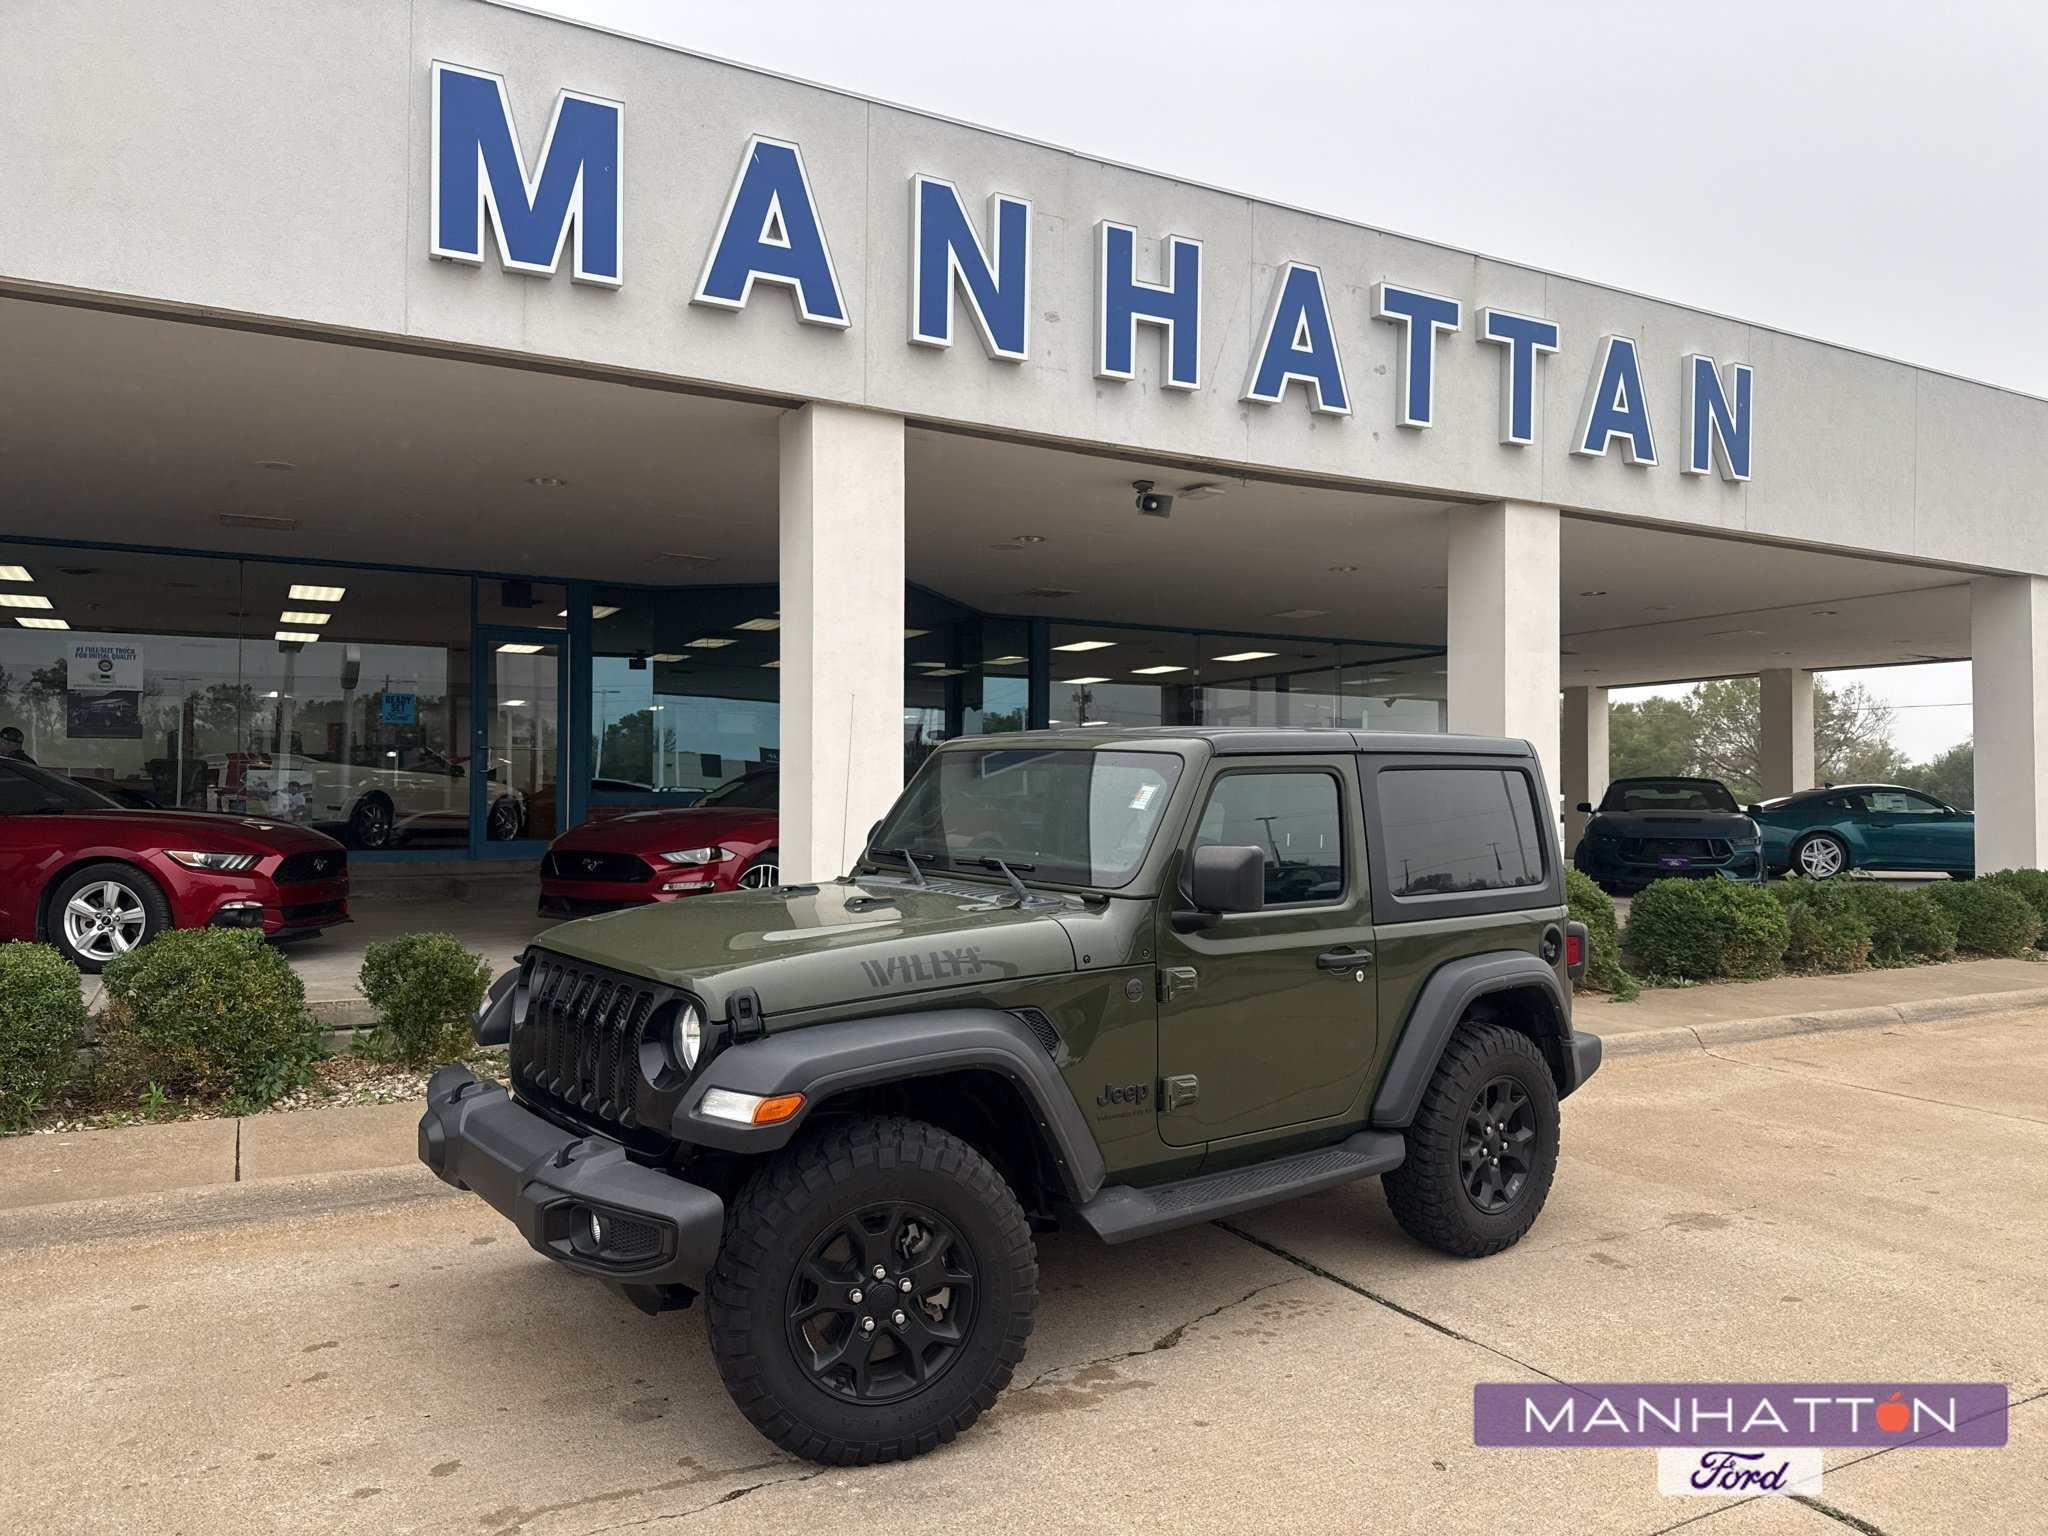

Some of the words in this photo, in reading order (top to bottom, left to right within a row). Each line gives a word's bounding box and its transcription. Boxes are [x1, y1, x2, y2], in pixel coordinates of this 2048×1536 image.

[429, 58, 1754, 484] MANHATTAN
[385, 695, 412, 704] READY
[390, 704, 406, 712] SET
[860, 946, 983, 988] WILLYS
[1096, 1083, 1150, 1107] Jeep
